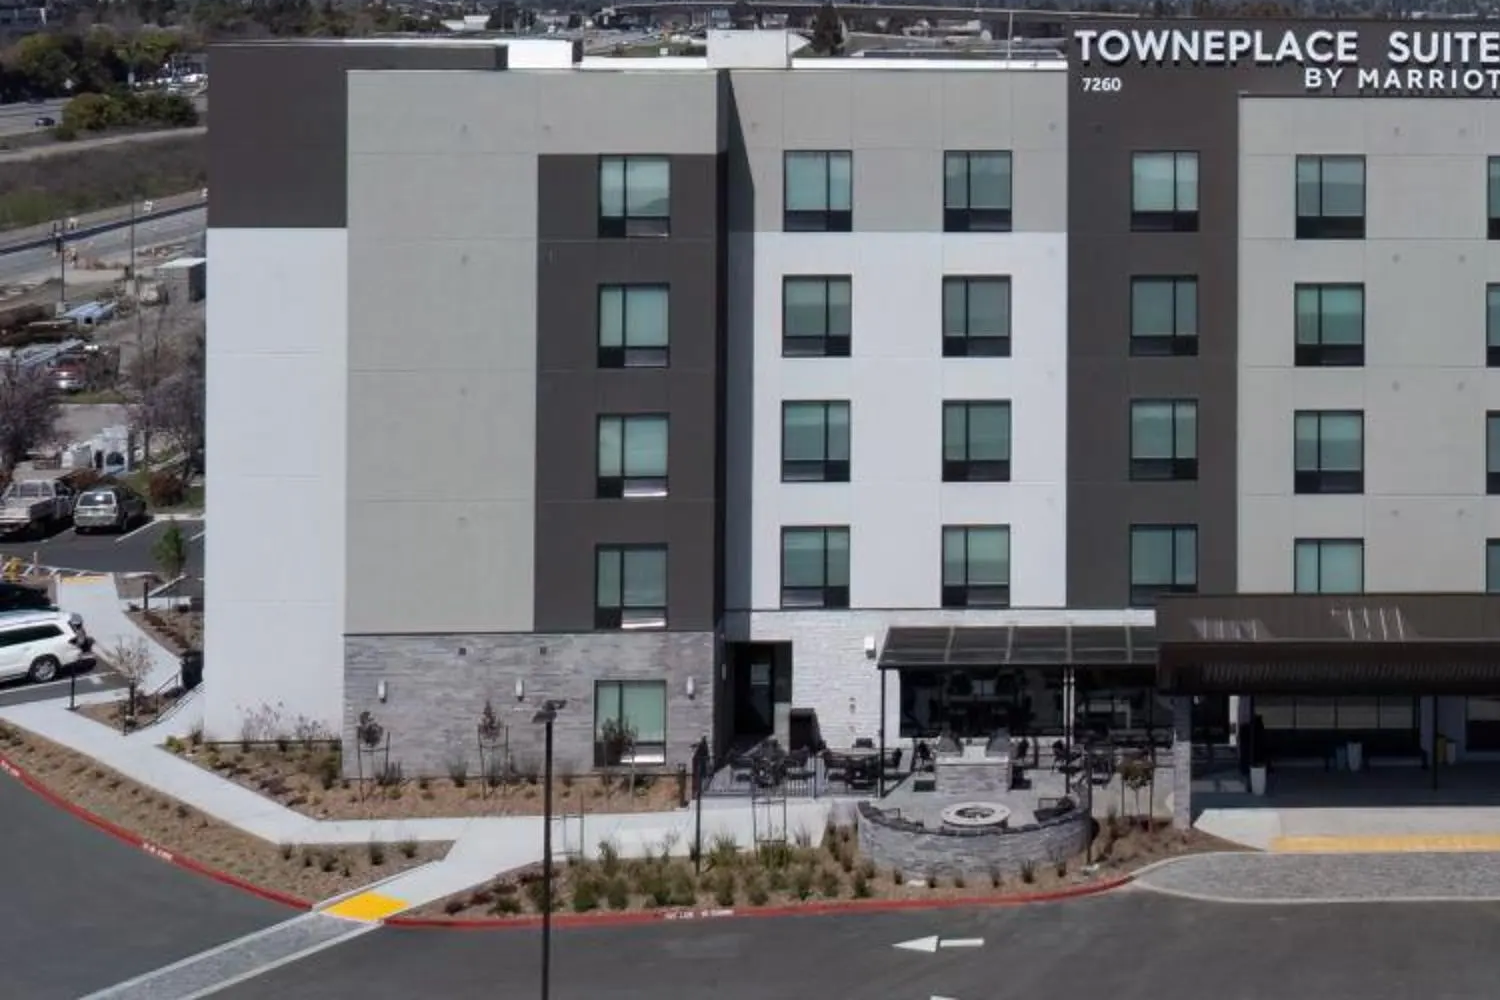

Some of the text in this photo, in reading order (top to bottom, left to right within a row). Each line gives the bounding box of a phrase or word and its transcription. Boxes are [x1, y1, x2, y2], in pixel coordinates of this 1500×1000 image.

[1074, 29, 1358, 62] TOWNEPLACE
[1082, 77, 1122, 92] 7260
[1304, 68, 1343, 88] BY
